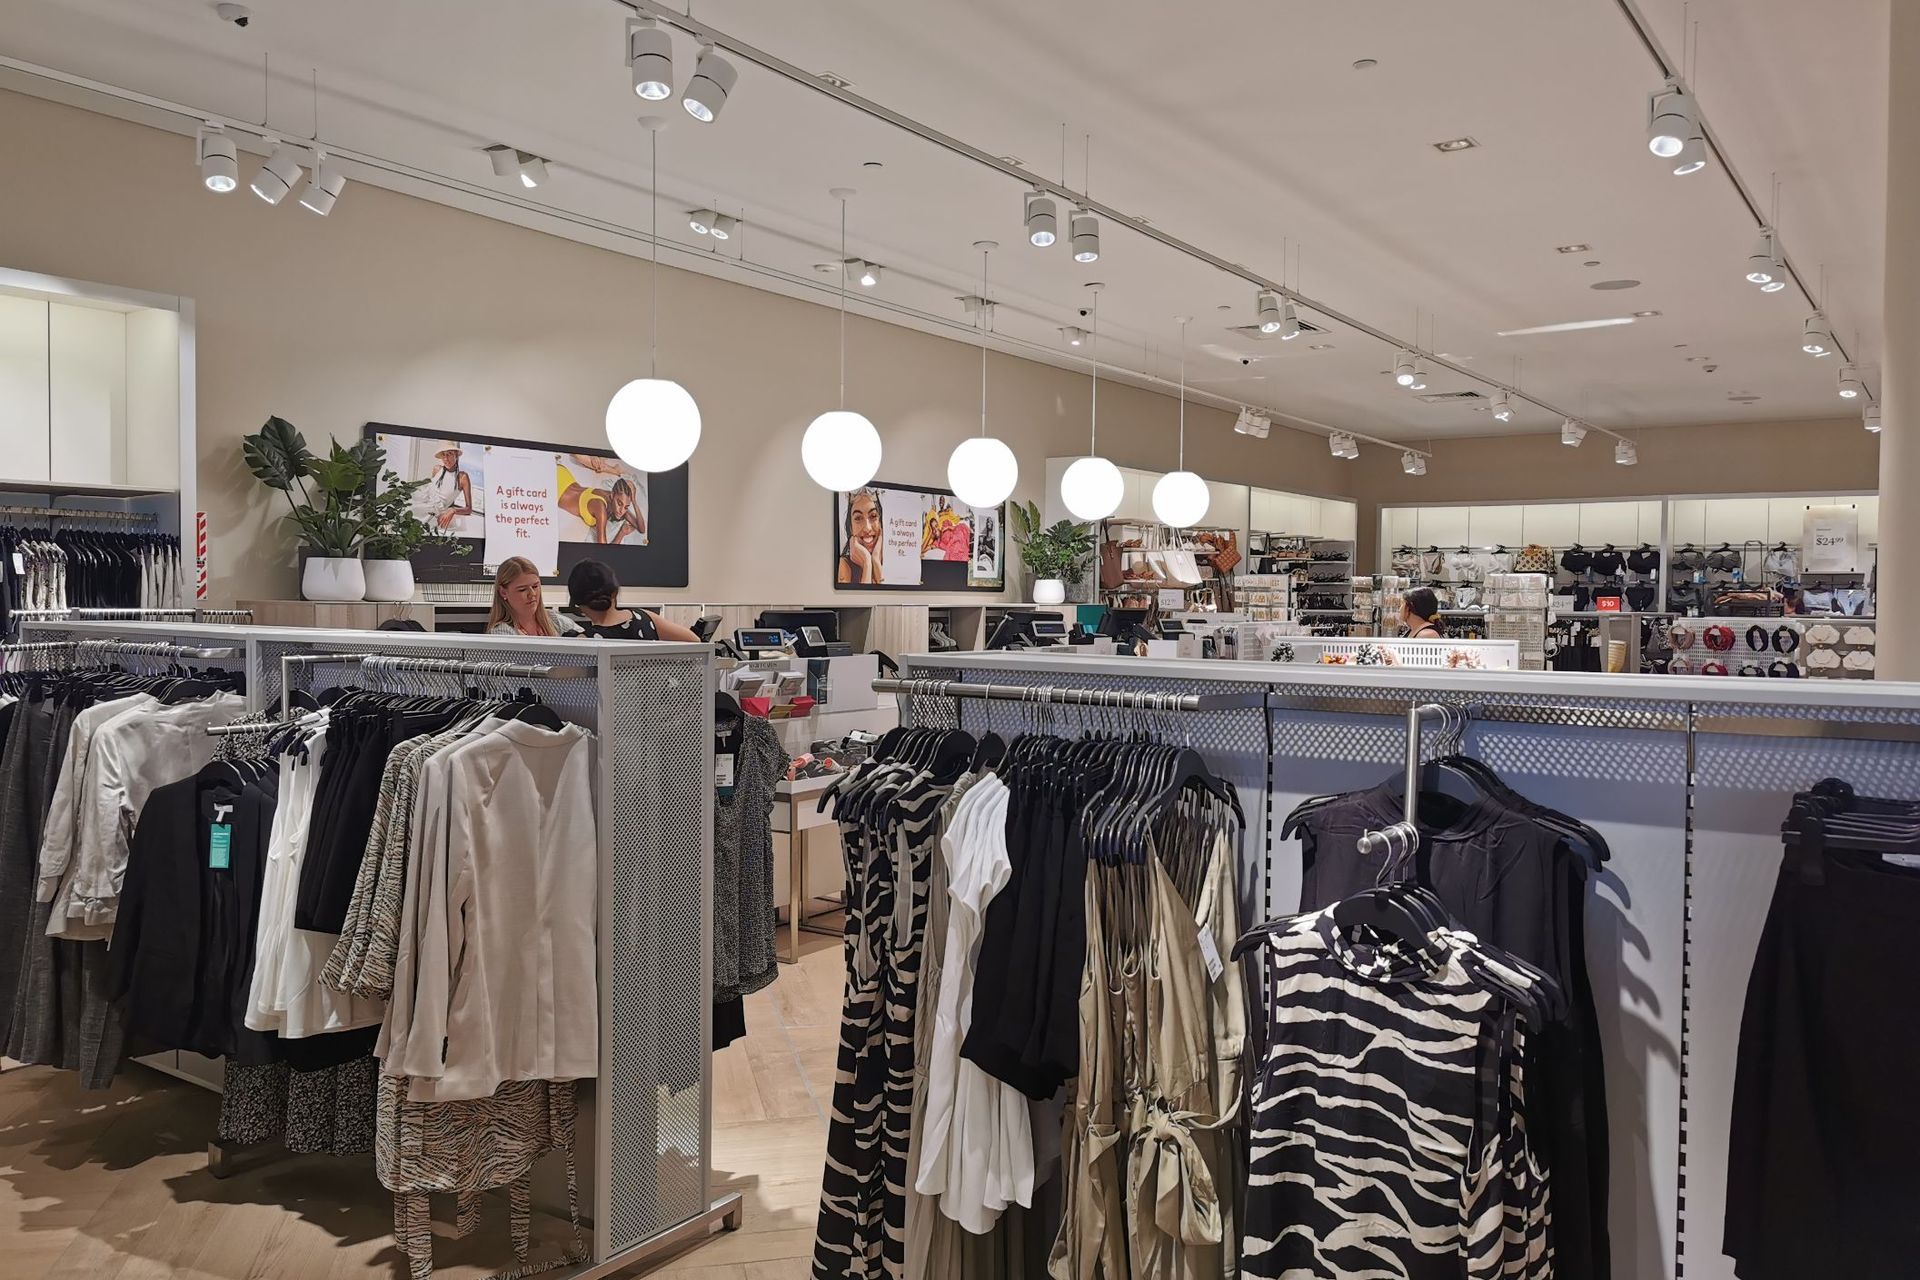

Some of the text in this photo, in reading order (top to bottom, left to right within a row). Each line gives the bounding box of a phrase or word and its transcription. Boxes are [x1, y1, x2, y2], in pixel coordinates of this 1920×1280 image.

[496, 485, 547, 498] A gift card
[501, 500, 544, 512] is always
[495, 514, 549, 526] the perfect
[516, 528, 531, 538] fit.
